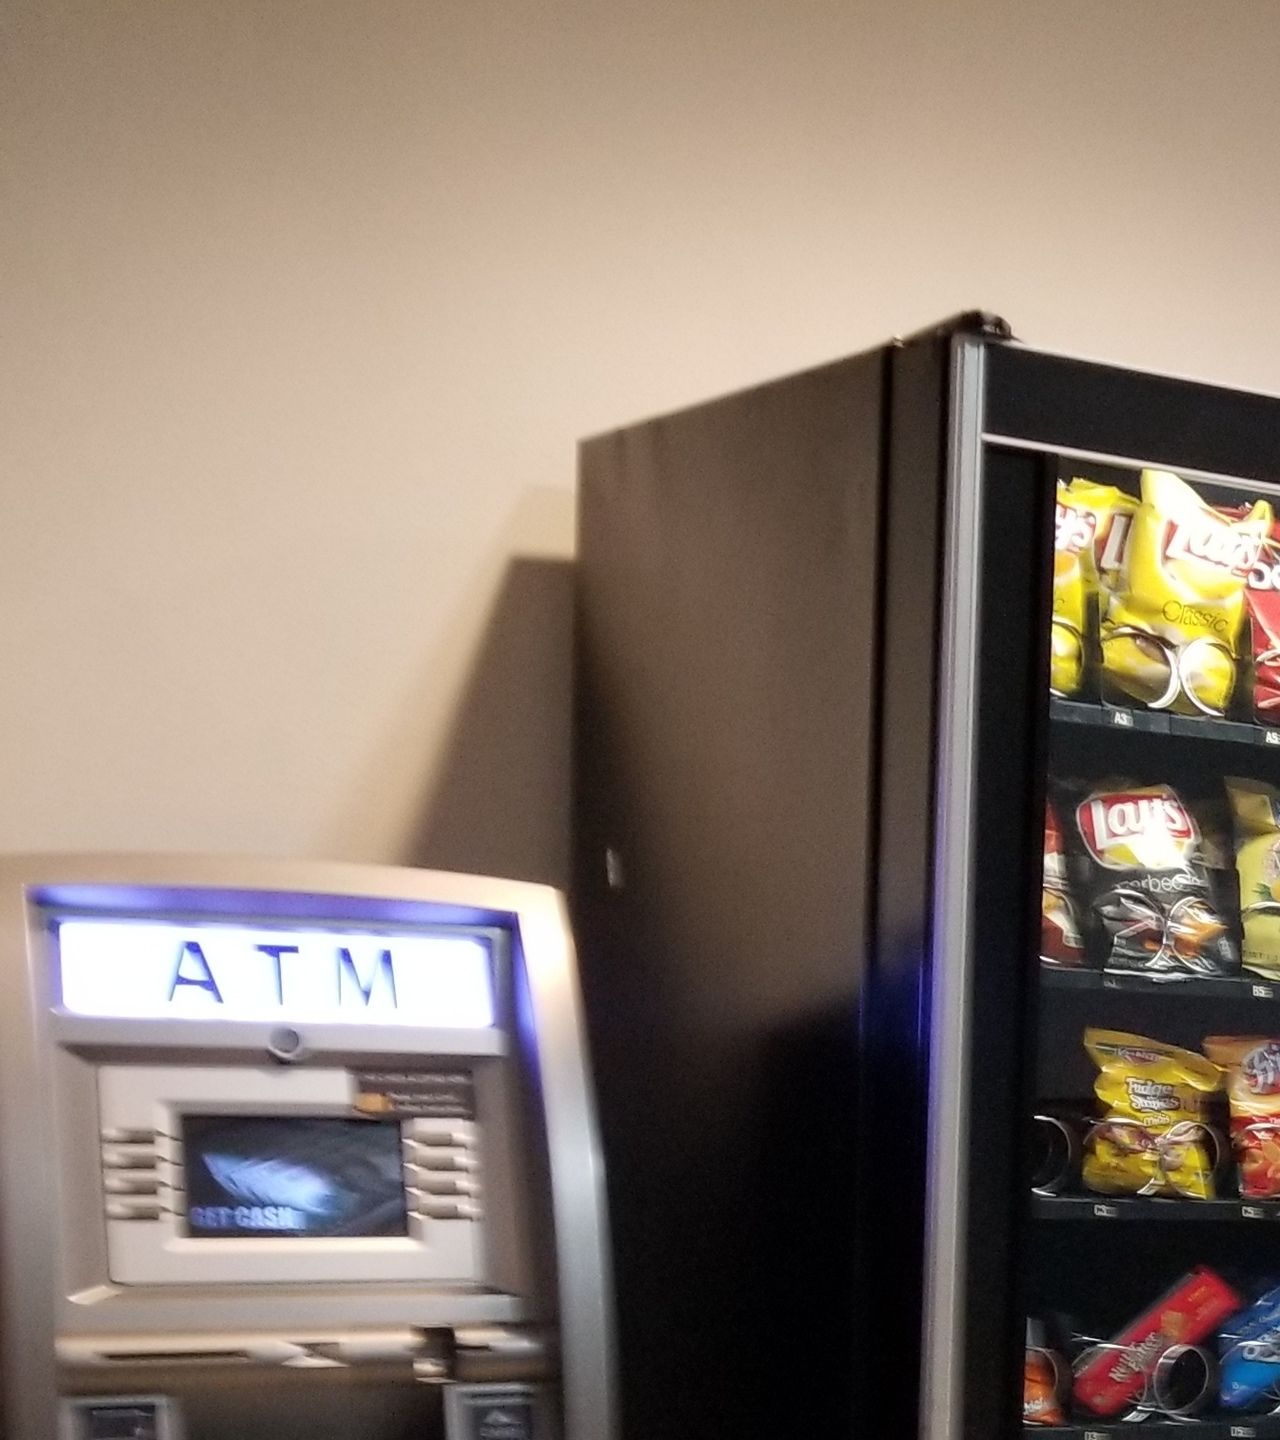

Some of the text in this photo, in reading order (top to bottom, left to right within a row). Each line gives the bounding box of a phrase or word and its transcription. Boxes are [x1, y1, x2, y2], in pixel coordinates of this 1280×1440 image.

[1162, 599, 1229, 634] Classic
[1090, 798, 1189, 851] Lay's
[167, 940, 399, 1009] ATM
[1126, 1077, 1173, 1096] Fudge
